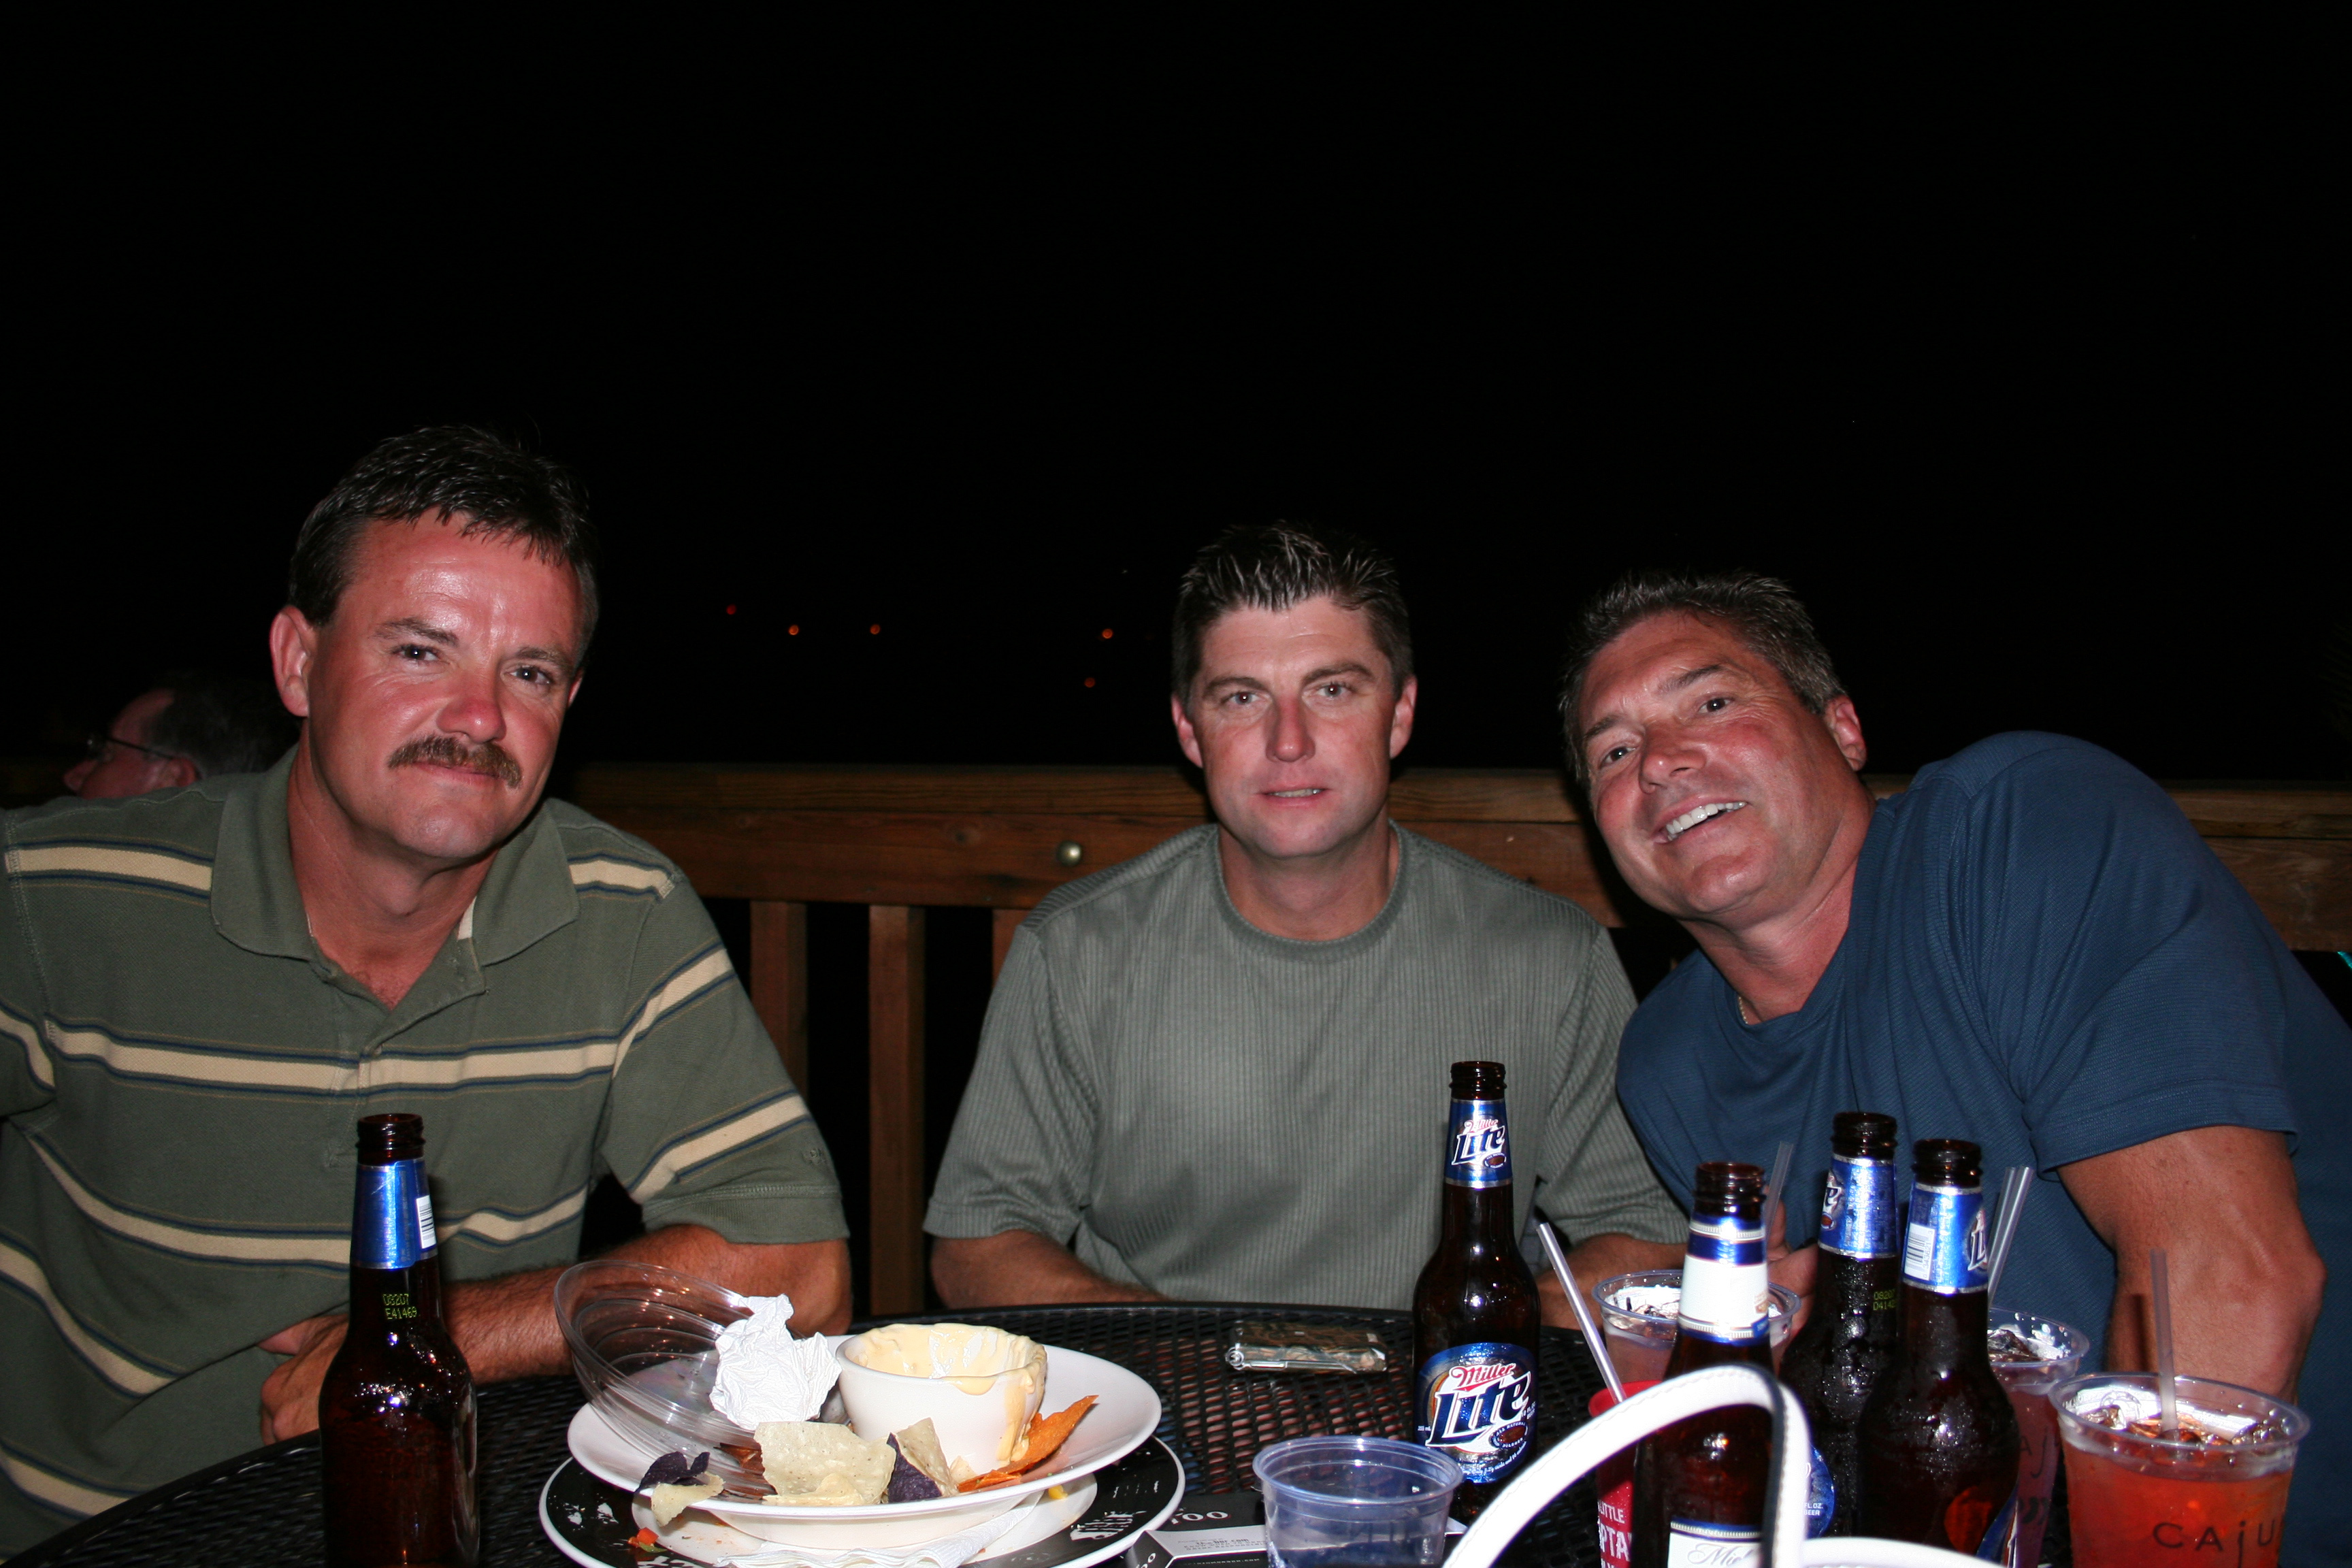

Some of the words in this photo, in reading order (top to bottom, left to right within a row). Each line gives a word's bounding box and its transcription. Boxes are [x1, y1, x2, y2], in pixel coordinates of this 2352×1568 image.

[1451, 1126, 1505, 1166] Lite
[1450, 1364, 1516, 1389] Miller
[1426, 1371, 1531, 1446] Lite
